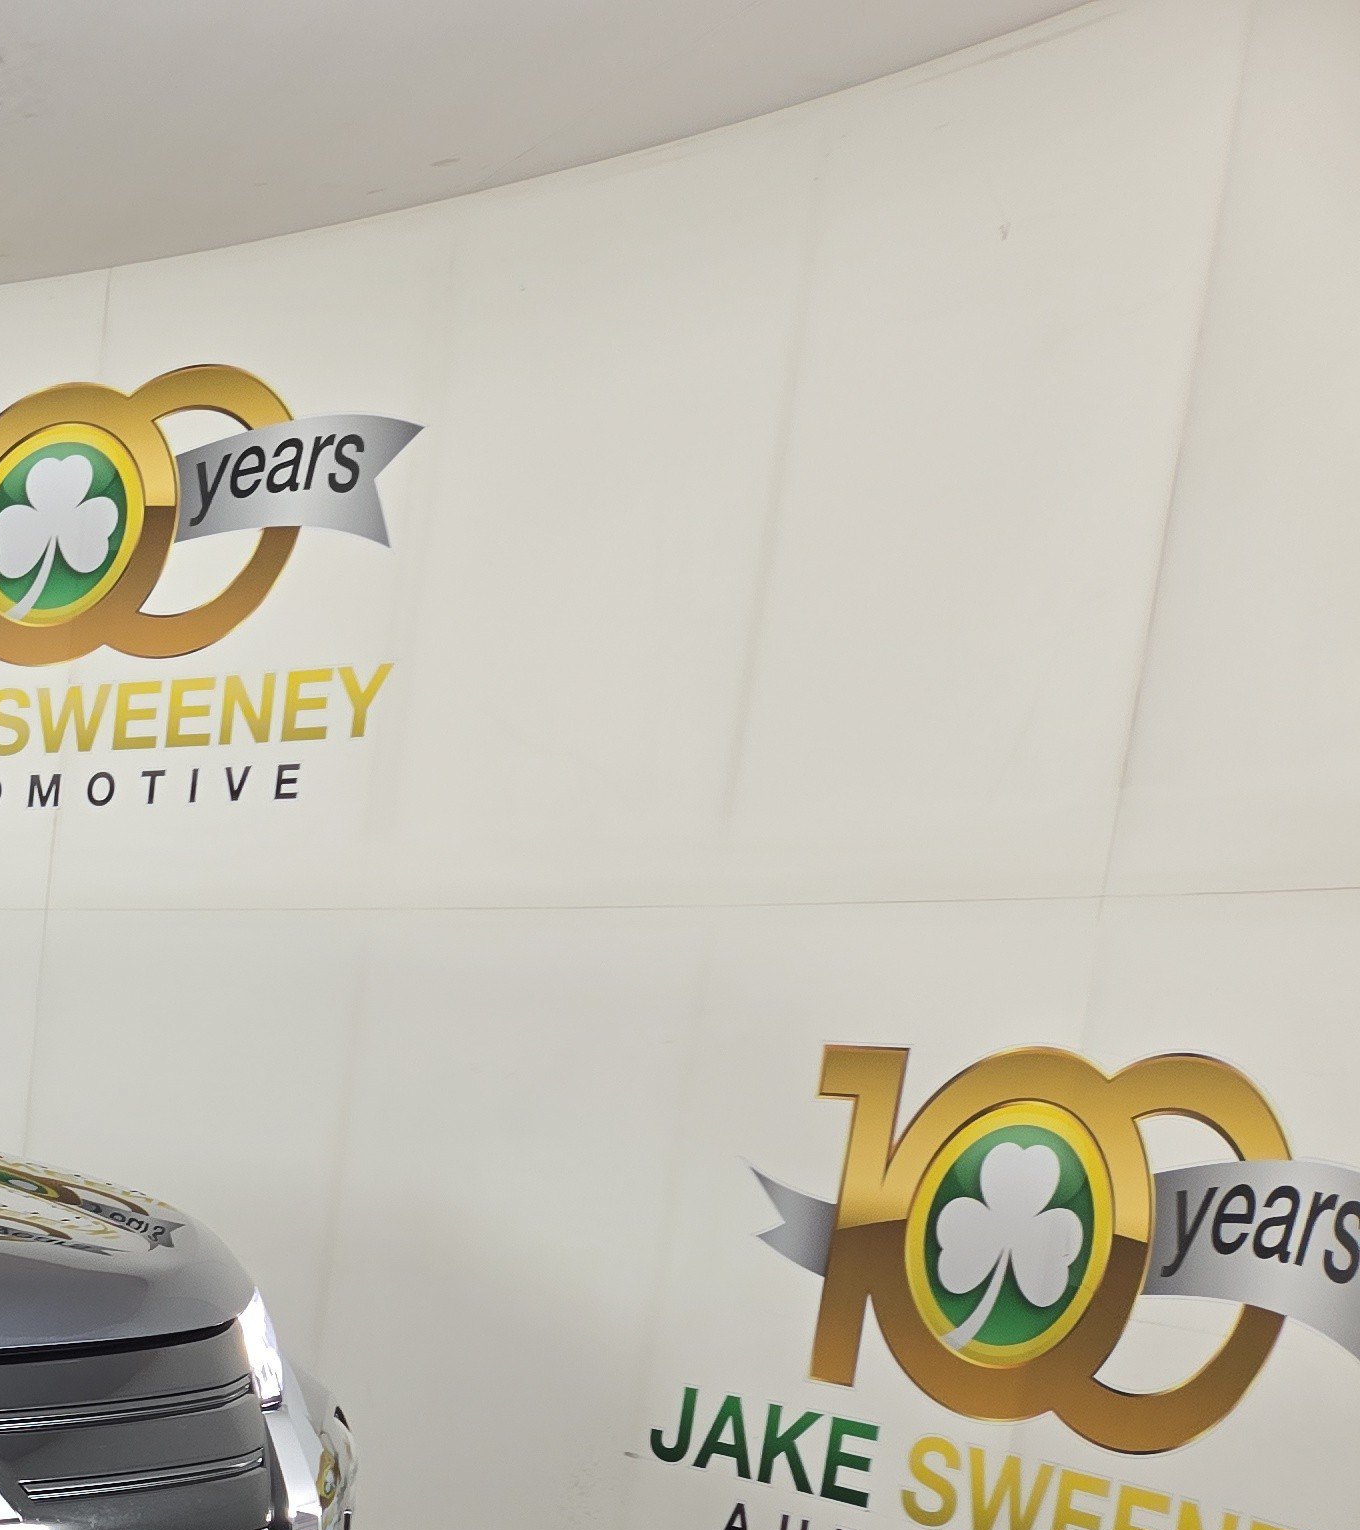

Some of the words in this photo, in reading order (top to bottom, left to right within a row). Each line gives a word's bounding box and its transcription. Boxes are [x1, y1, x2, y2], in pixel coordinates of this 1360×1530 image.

[189, 431, 365, 526] years
[808, 1044, 1292, 1455] 100
[1160, 1181, 1360, 1285] years
[650, 1386, 880, 1508] JAKE
